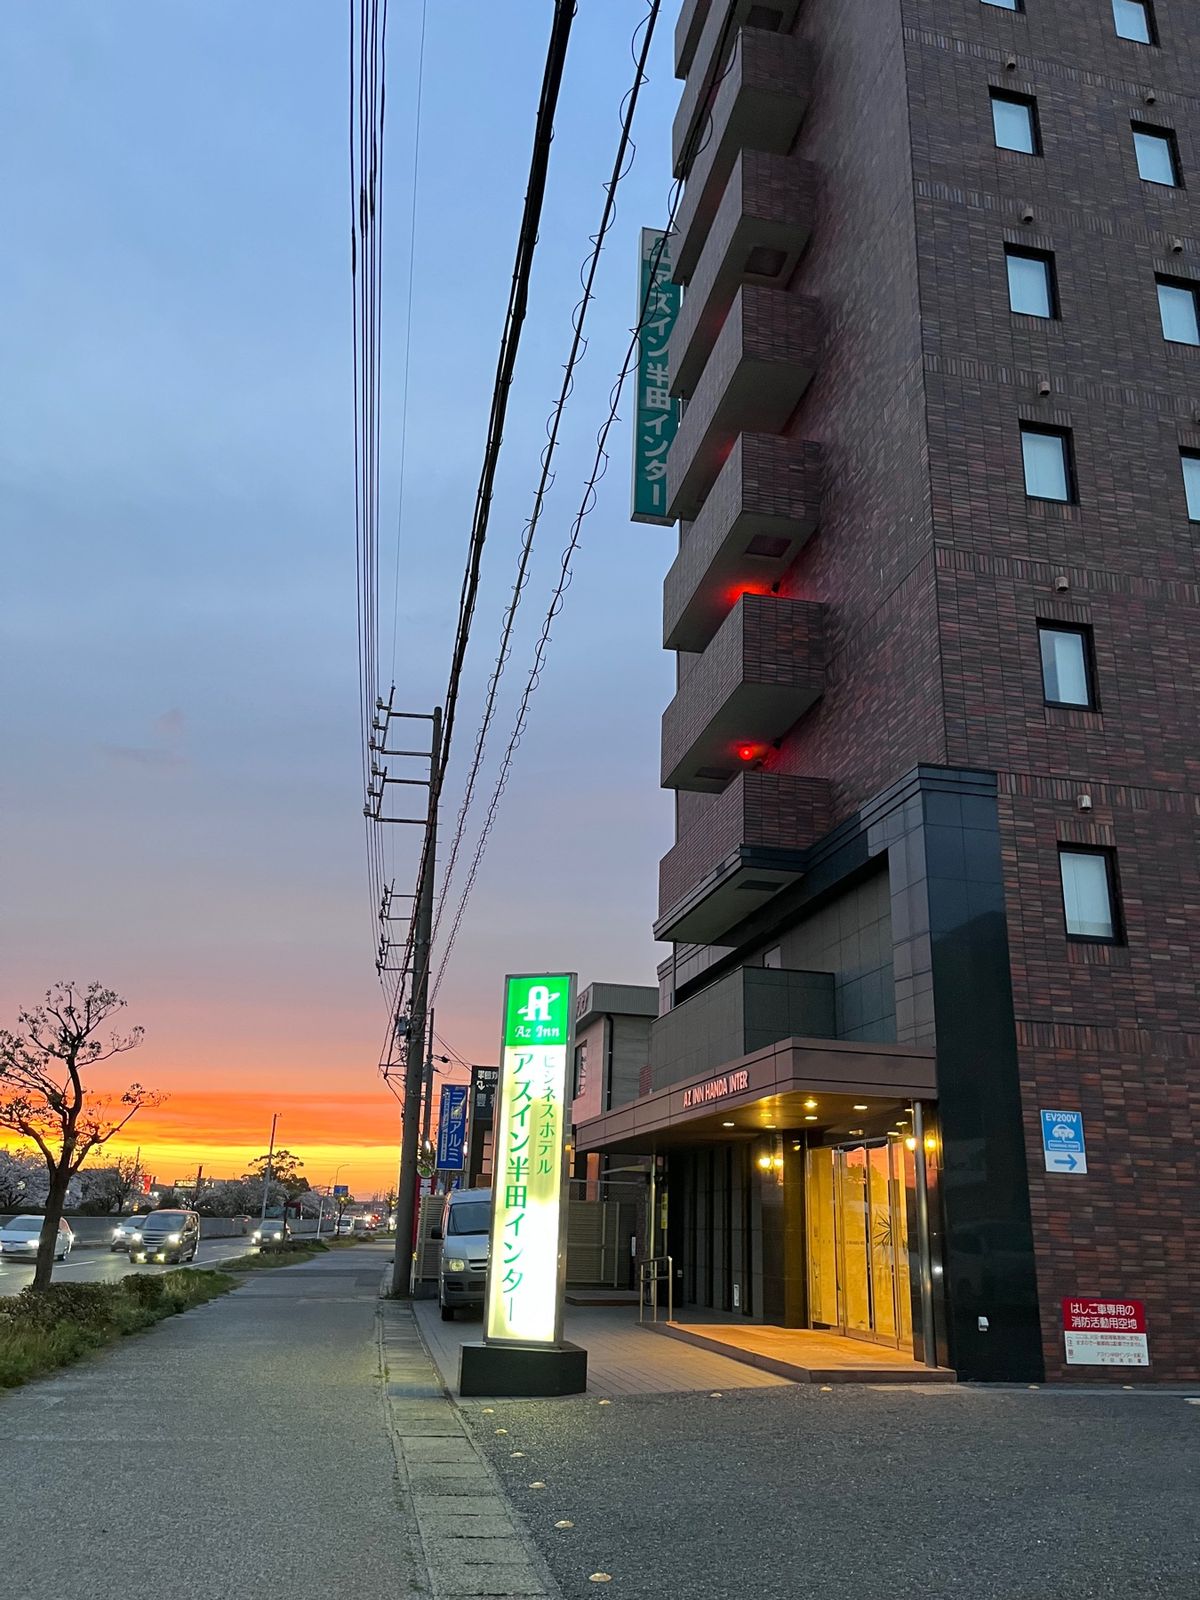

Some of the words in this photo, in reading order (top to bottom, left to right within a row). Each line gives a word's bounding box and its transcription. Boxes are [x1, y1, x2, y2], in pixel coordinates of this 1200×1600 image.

[644, 270, 672, 506] アズイン半田インター
[515, 1025, 531, 1038] Az
[535, 1025, 560, 1038] Inn
[692, 1085, 704, 1105] INN
[705, 1077, 728, 1101] HANDA
[729, 1070, 749, 1093] INTER
[1045, 1112, 1077, 1123] EV200V
[501, 1053, 534, 1322] アズイン半田インター
[1070, 1302, 1135, 1316] はしご車専用の
[1071, 1315, 1138, 1330] 消防活動用空地
